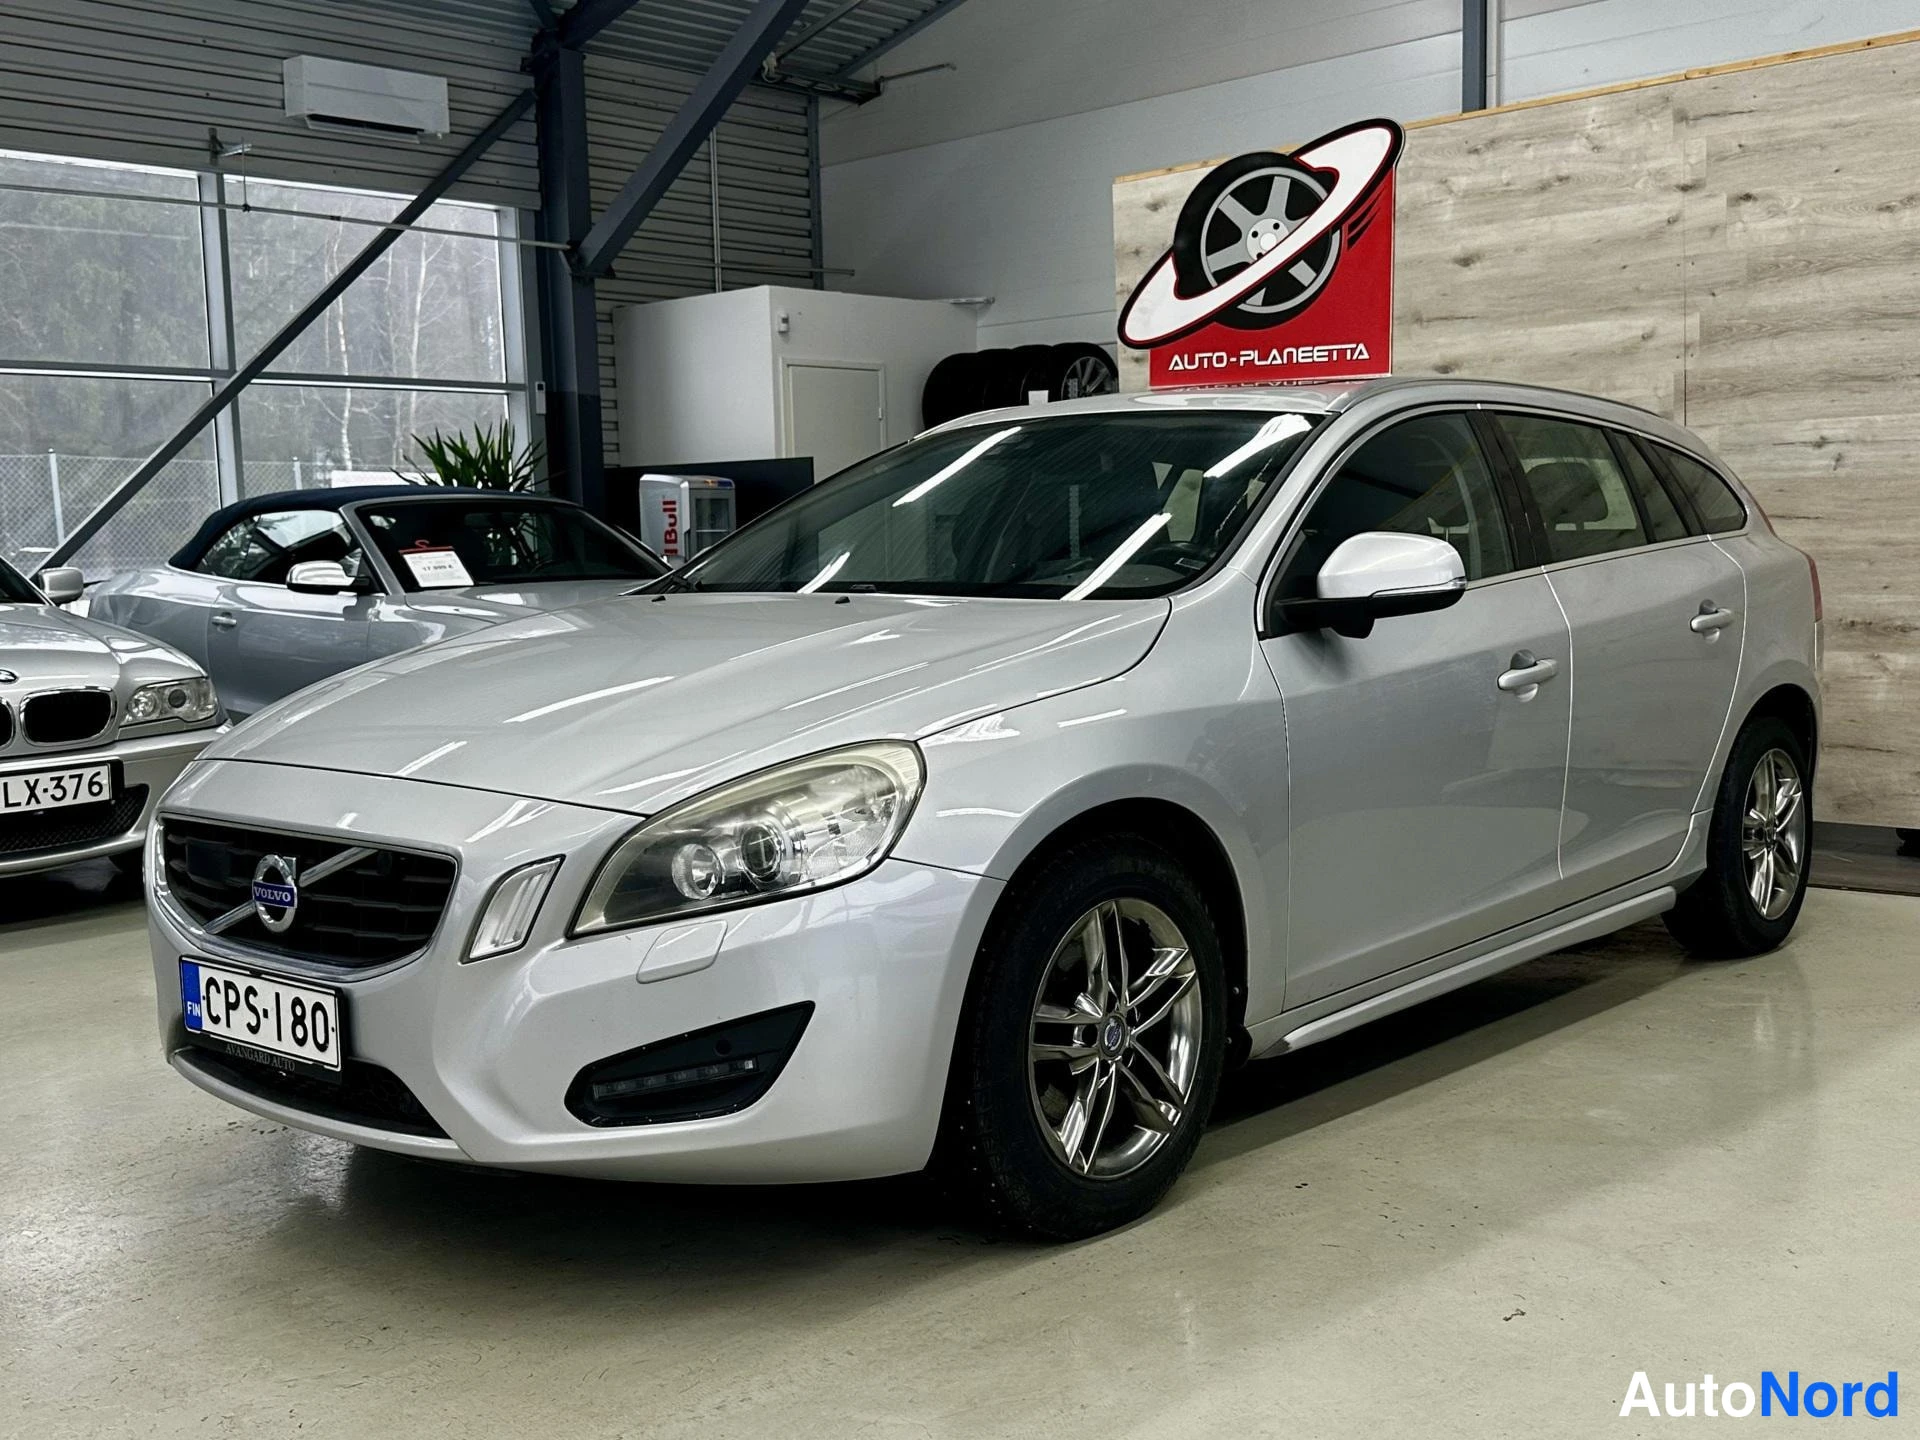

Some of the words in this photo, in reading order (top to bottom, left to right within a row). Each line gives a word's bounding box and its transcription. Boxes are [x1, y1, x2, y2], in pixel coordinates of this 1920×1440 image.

[1168, 343, 1370, 371] AUTO-PLANEETTA
[662, 500, 678, 544] Bull
[3, 770, 104, 808] LX-376
[254, 886, 292, 902] VOLVO
[187, 1001, 201, 1017] FIN
[205, 976, 330, 1053] CPS-180
[226, 1043, 271, 1065] AVANGARD
[271, 1058, 296, 1072] AUTO
